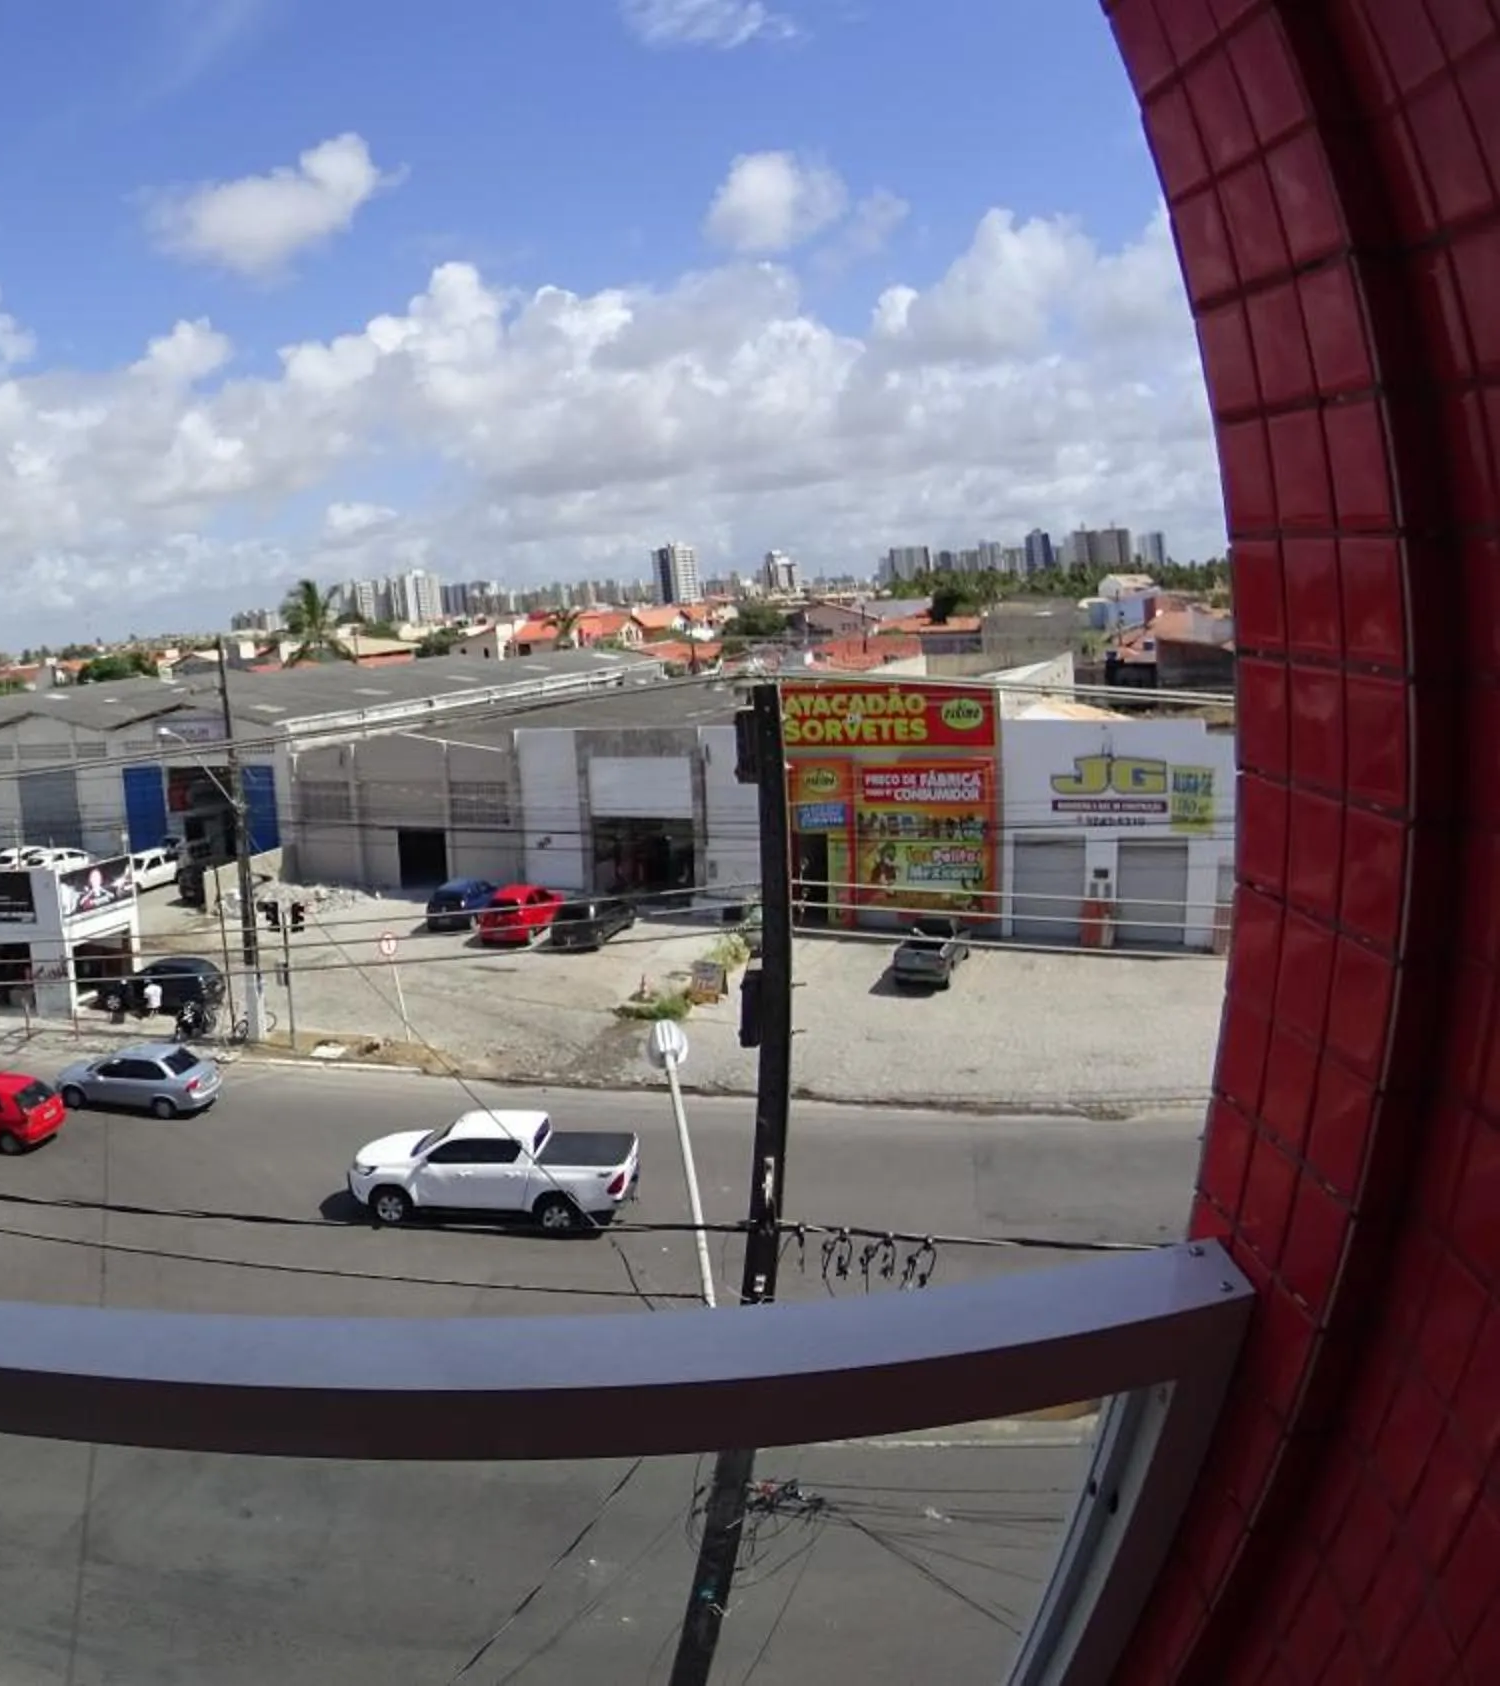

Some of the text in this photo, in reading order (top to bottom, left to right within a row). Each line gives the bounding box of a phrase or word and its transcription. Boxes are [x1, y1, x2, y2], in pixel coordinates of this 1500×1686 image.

[785, 687, 927, 717] ATACADÃO
[784, 717, 928, 743] SORVETES
[920, 769, 981, 787] FÁBRICA
[1051, 755, 1167, 794] JG
[894, 787, 980, 801] CONSUMIDOR
